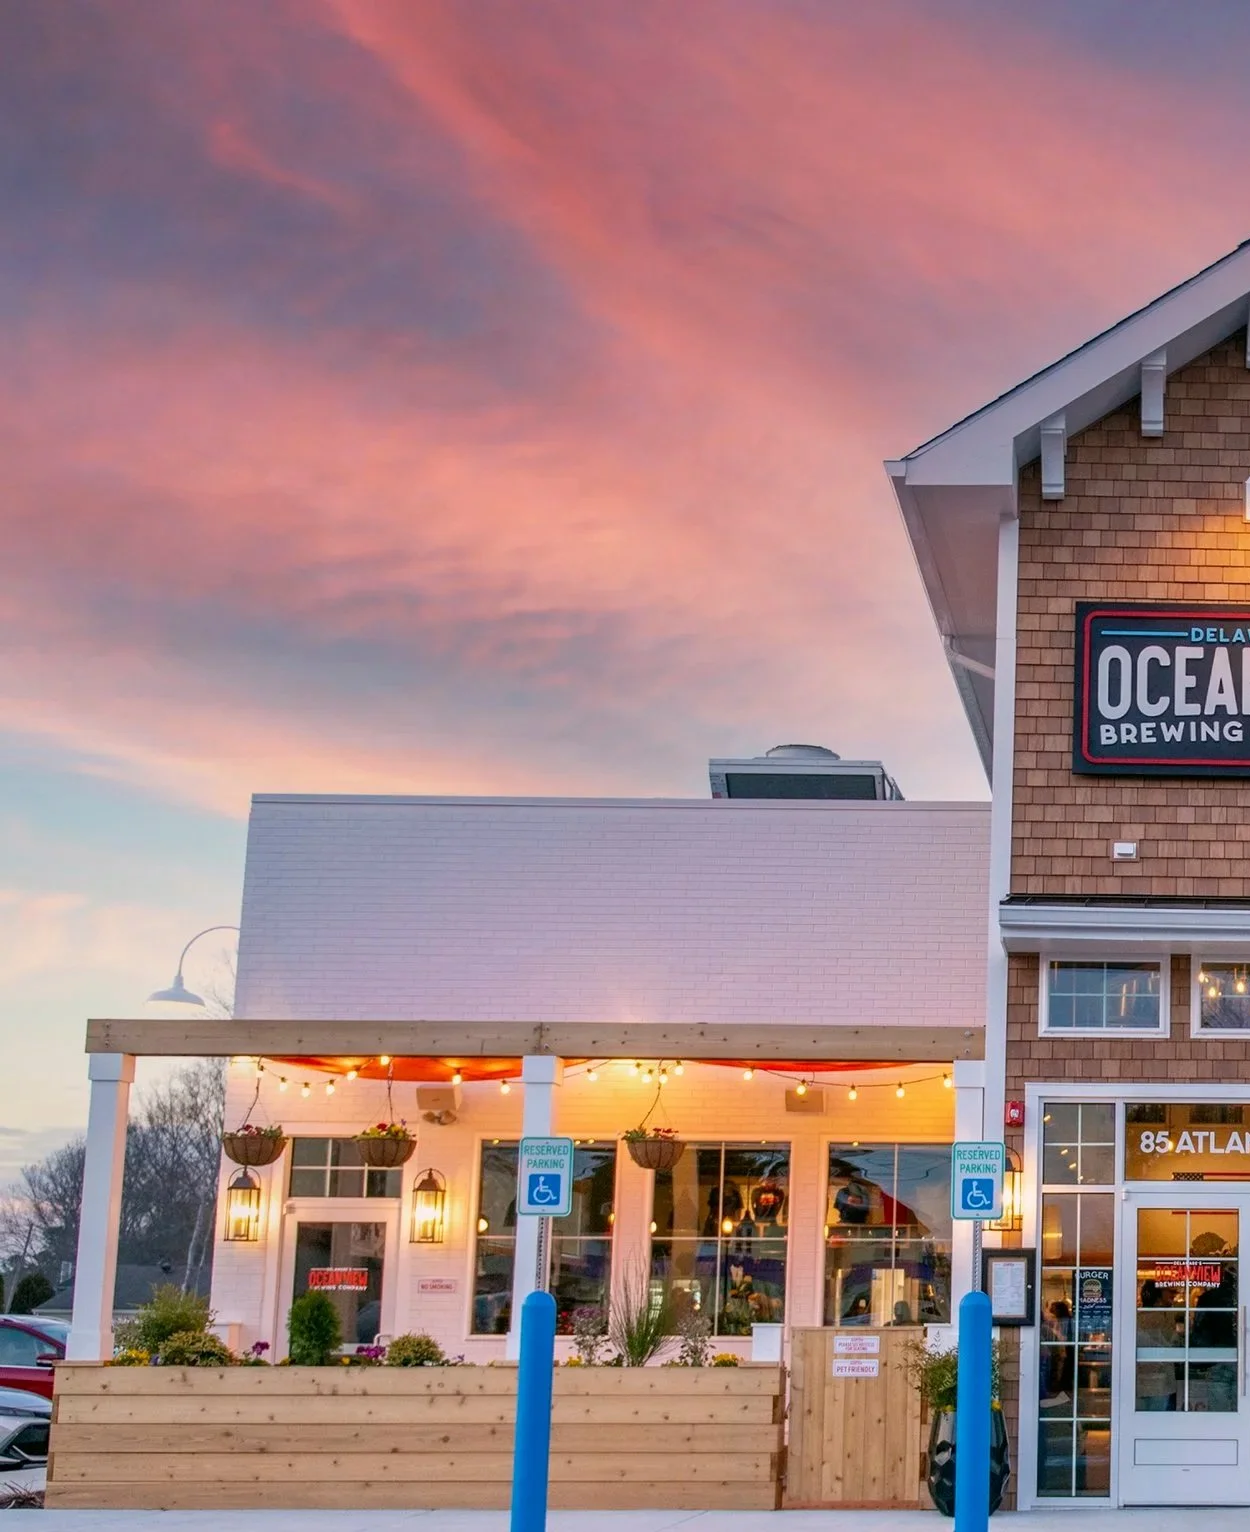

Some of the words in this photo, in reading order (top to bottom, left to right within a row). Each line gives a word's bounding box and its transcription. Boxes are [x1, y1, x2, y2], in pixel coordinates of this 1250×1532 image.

[1100, 721, 1243, 745] BREWING
[1140, 1131, 1169, 1154] 85
[524, 1145, 568, 1155] RESERVED
[956, 1150, 1000, 1160] RESERVED
[527, 1159, 564, 1168] PARKING
[960, 1164, 997, 1173] PARKING
